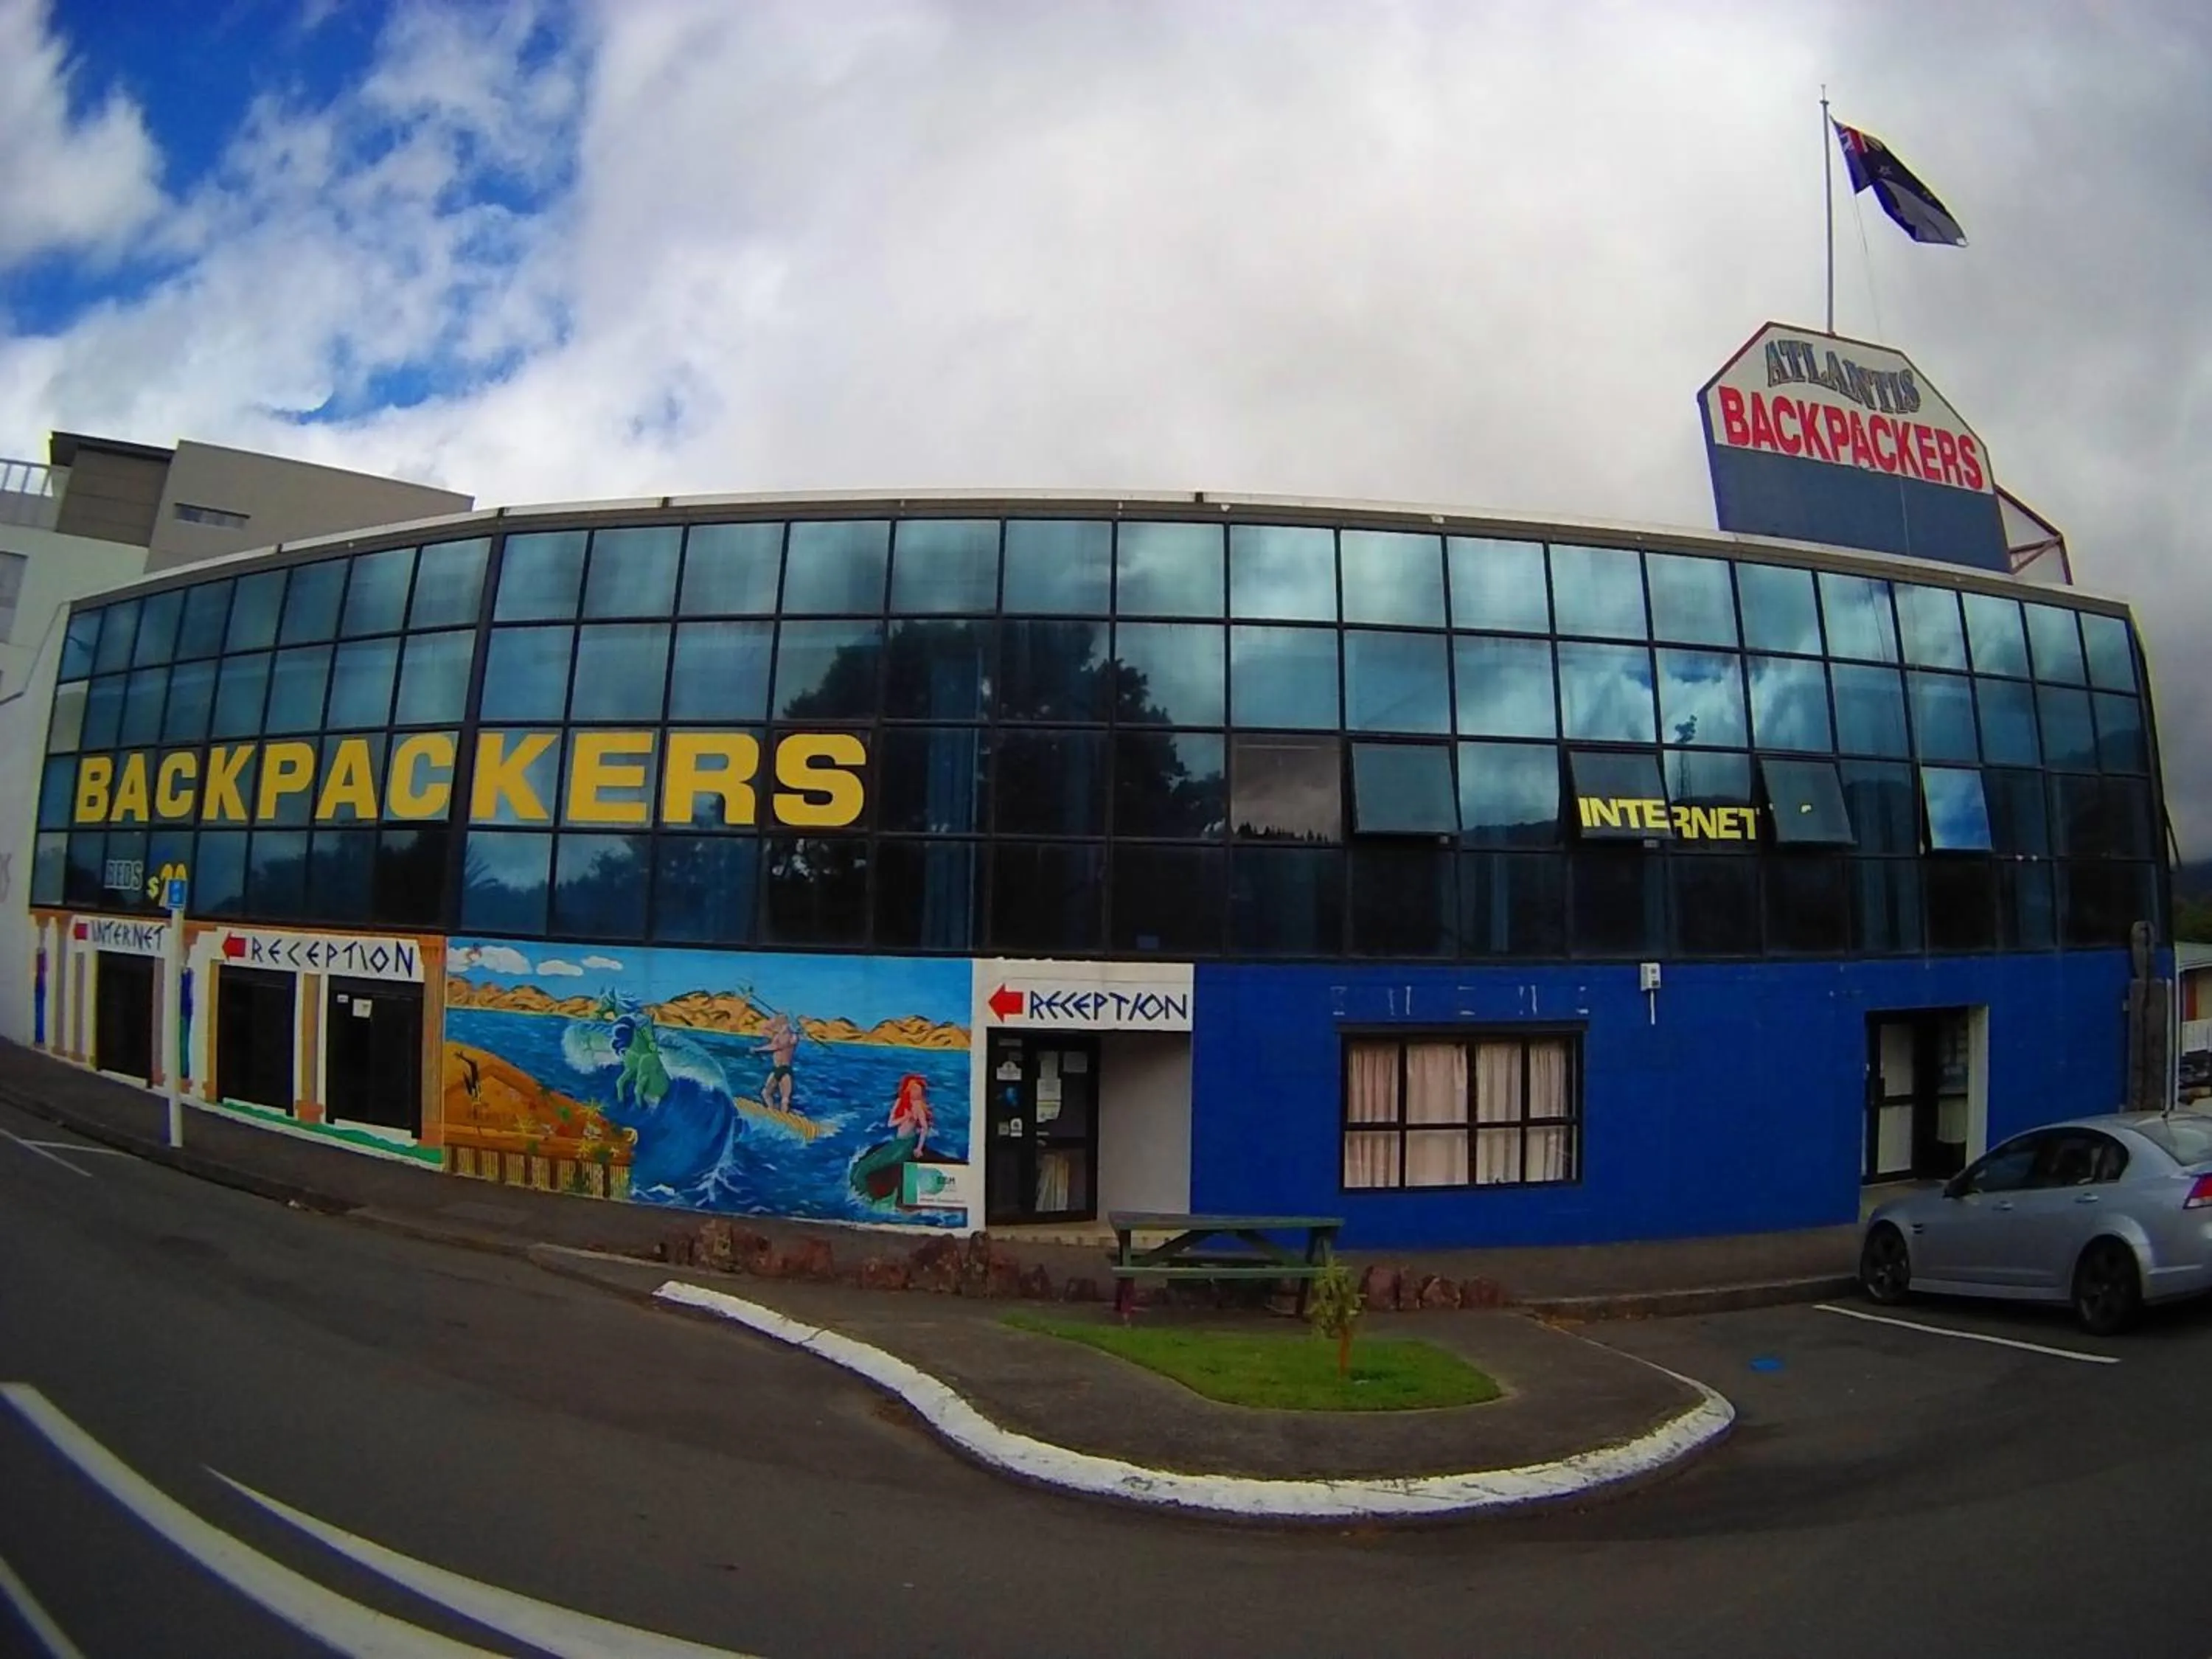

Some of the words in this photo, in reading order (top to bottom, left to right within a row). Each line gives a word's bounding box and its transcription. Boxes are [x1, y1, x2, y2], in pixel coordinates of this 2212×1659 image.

[1765, 339, 1921, 414] ATLANTIS
[1718, 385, 1983, 490] BACKPACKERS
[75, 731, 866, 827] BACKPACKERS
[1578, 797, 1759, 840] INTERNET
[91, 919, 165, 952] INTERNET
[251, 938, 414, 978] RECEPTION
[1029, 990, 1187, 1020] RECEPTION
